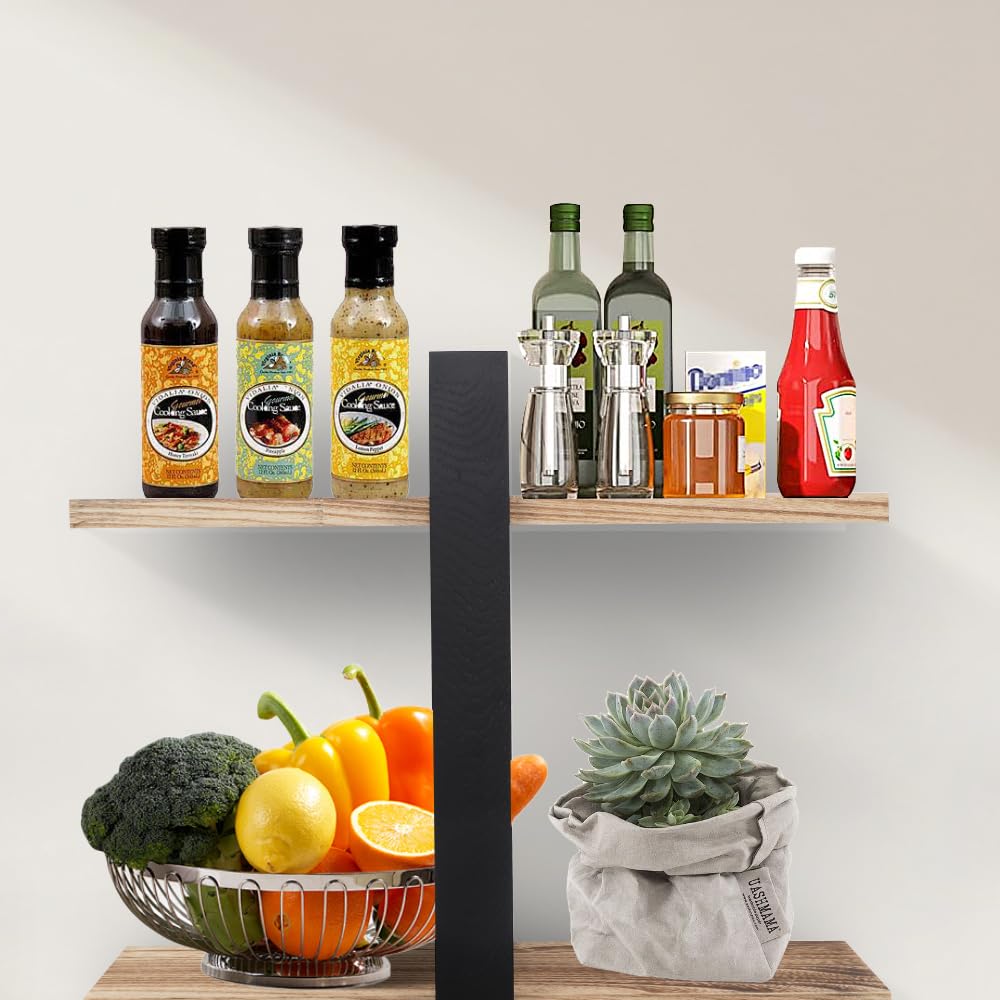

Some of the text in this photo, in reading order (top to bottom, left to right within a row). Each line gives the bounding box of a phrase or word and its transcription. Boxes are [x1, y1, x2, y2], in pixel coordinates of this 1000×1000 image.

[284, 384, 306, 401] NION
[375, 382, 400, 399] ONION
[279, 402, 301, 412] Sauce
[374, 400, 396, 409] Sauce
[186, 407, 208, 416] Sauce
[748, 877, 780, 934] UASHMAMA
